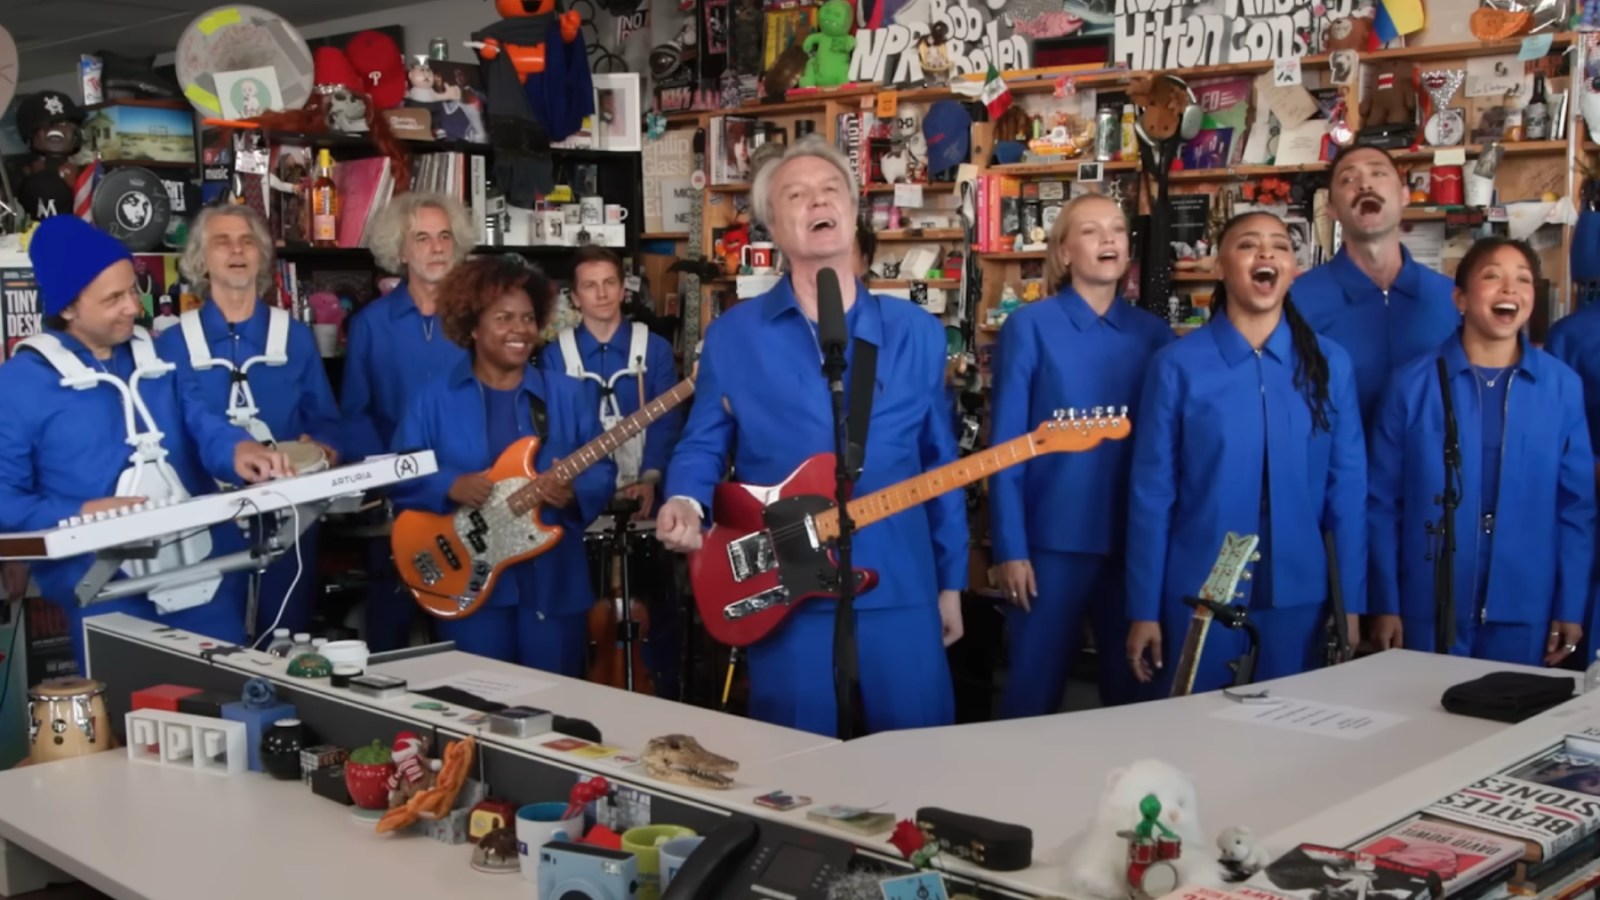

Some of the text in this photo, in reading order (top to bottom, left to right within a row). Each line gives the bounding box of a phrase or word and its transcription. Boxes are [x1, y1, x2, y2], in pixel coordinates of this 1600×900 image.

[930, 0, 983, 42] Bob
[848, 22, 925, 83] NPR
[946, 19, 1030, 80] Boilen
[1113, 12, 1225, 70] Hilton
[368, 70, 382, 86] P
[205, 164, 229, 180] music
[644, 157, 690, 176] Glass
[37, 196, 59, 219] M
[754, 252, 766, 266] n
[5, 289, 38, 313] TINY
[7, 313, 43, 337] DESK
[331, 471, 373, 487] ARTURIA
[132, 719, 222, 760] npr
[1472, 776, 1600, 818] STONES
[1438, 793, 1575, 835] BEATLES
[1400, 827, 1452, 844] BOWIE
[1451, 839, 1502, 855] DAVID
